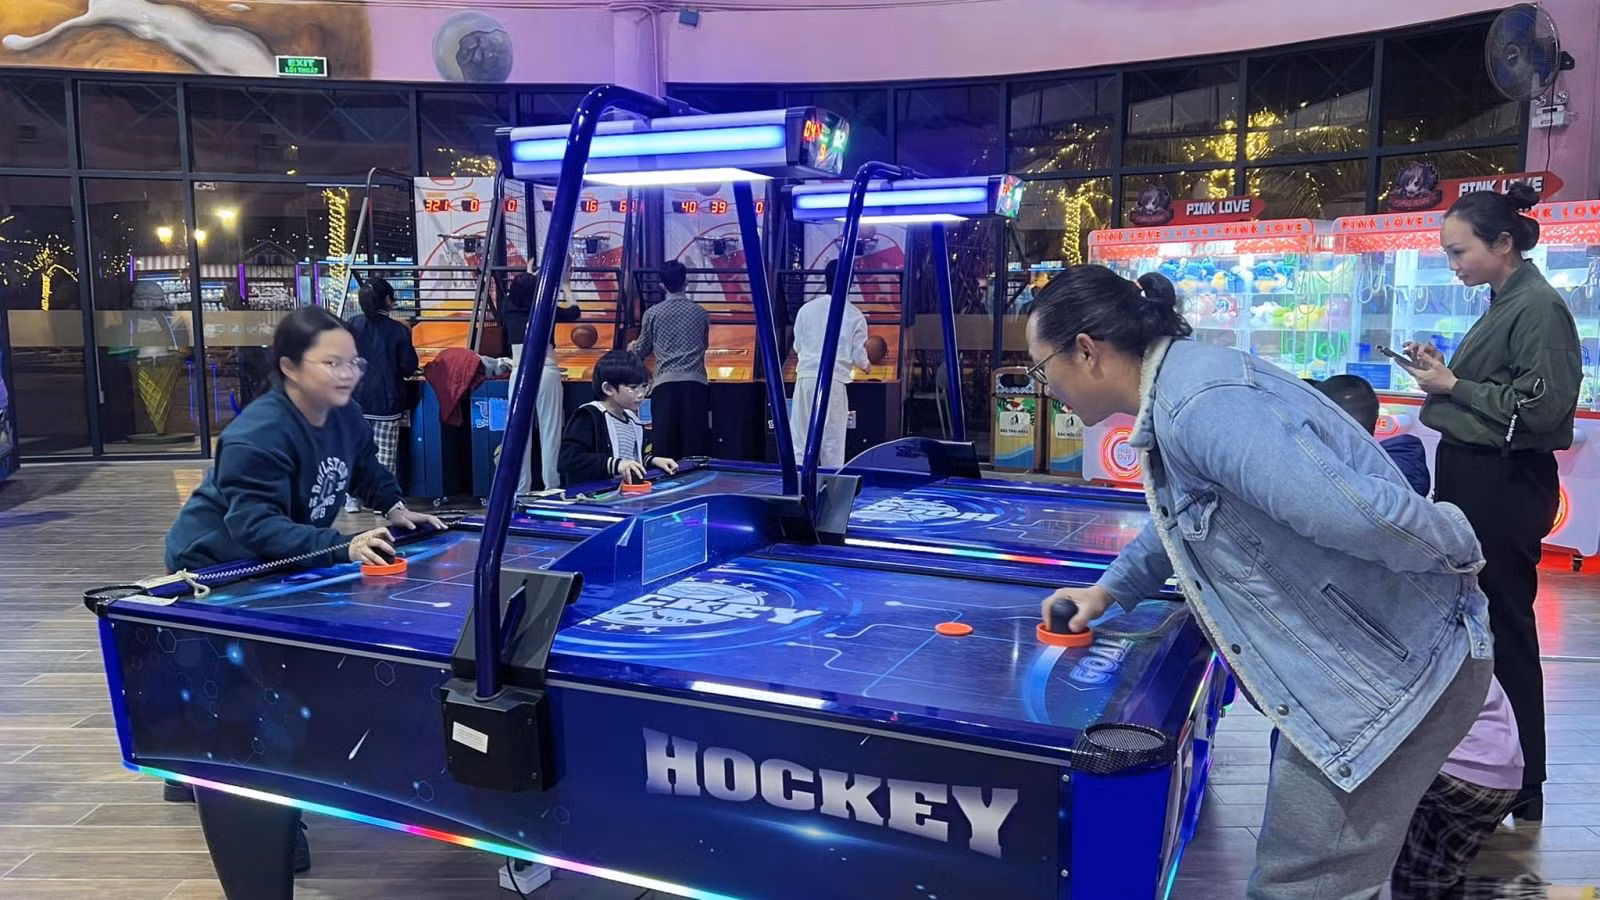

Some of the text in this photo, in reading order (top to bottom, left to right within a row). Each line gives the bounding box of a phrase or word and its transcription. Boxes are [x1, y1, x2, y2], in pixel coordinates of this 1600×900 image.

[287, 58, 315, 66] EXIT
[1502, 176, 1543, 195] LE
[425, 200, 449, 211] 321
[585, 200, 597, 212] 16
[681, 201, 697, 213] 40
[711, 201, 727, 213] 39
[1186, 199, 1251, 215] PINK LOVE
[1224, 223, 1302, 235] PINK LOVE
[1341, 216, 1423, 230] PINK LOVE
[1095, 230, 1161, 241] PINK LOVE
[642, 727, 1019, 859] HOCKEY
